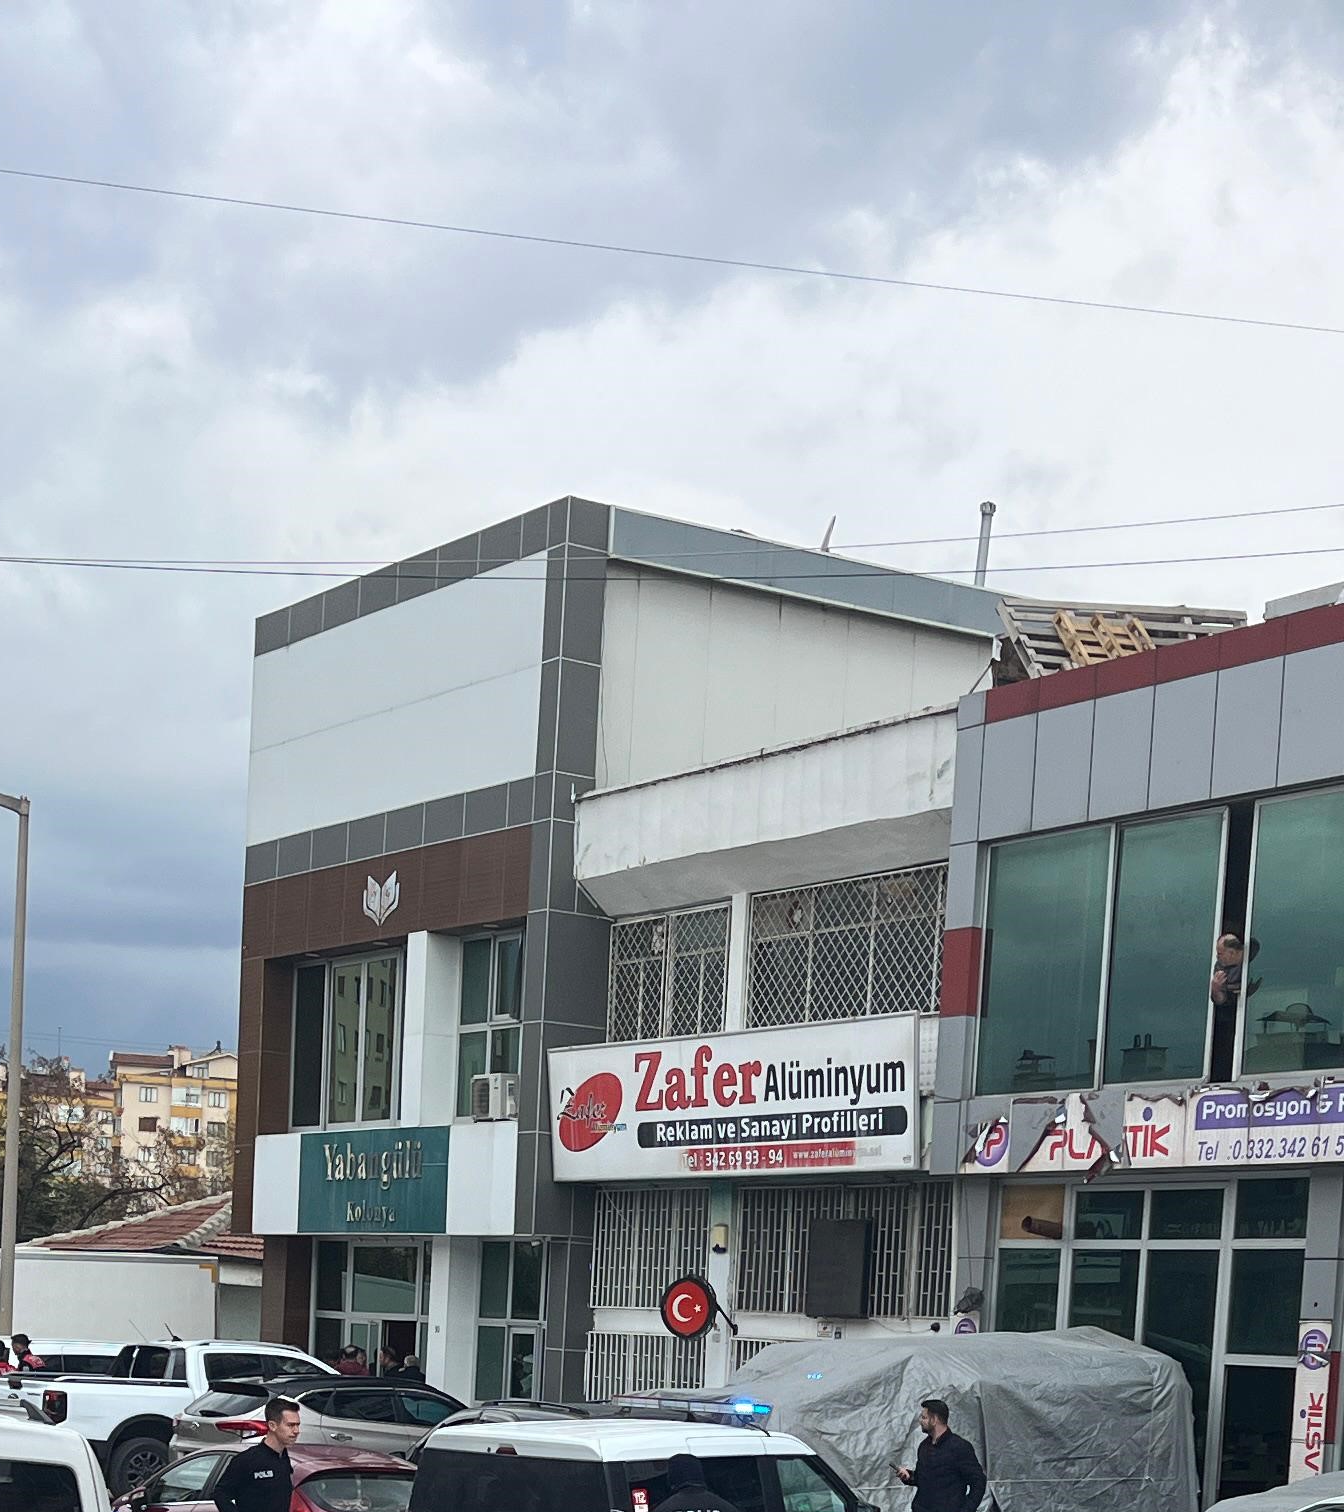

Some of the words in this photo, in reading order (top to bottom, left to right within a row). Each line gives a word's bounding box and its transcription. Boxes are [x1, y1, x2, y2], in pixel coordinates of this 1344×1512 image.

[634, 1044, 762, 1112] Zafer
[763, 1057, 906, 1105] Alüminyum
[1202, 1098, 1311, 1121] Promosyon
[656, 1119, 713, 1142] Reklam
[717, 1121, 736, 1139] ve
[740, 1115, 797, 1139] Sanayi
[802, 1110, 884, 1134] Profilleri
[705, 1151, 726, 1168] 342
[728, 1150, 743, 1166] 69
[745, 1150, 759, 1165] 93
[768, 1149, 784, 1164] 94
[1197, 1141, 1217, 1161] Tel
